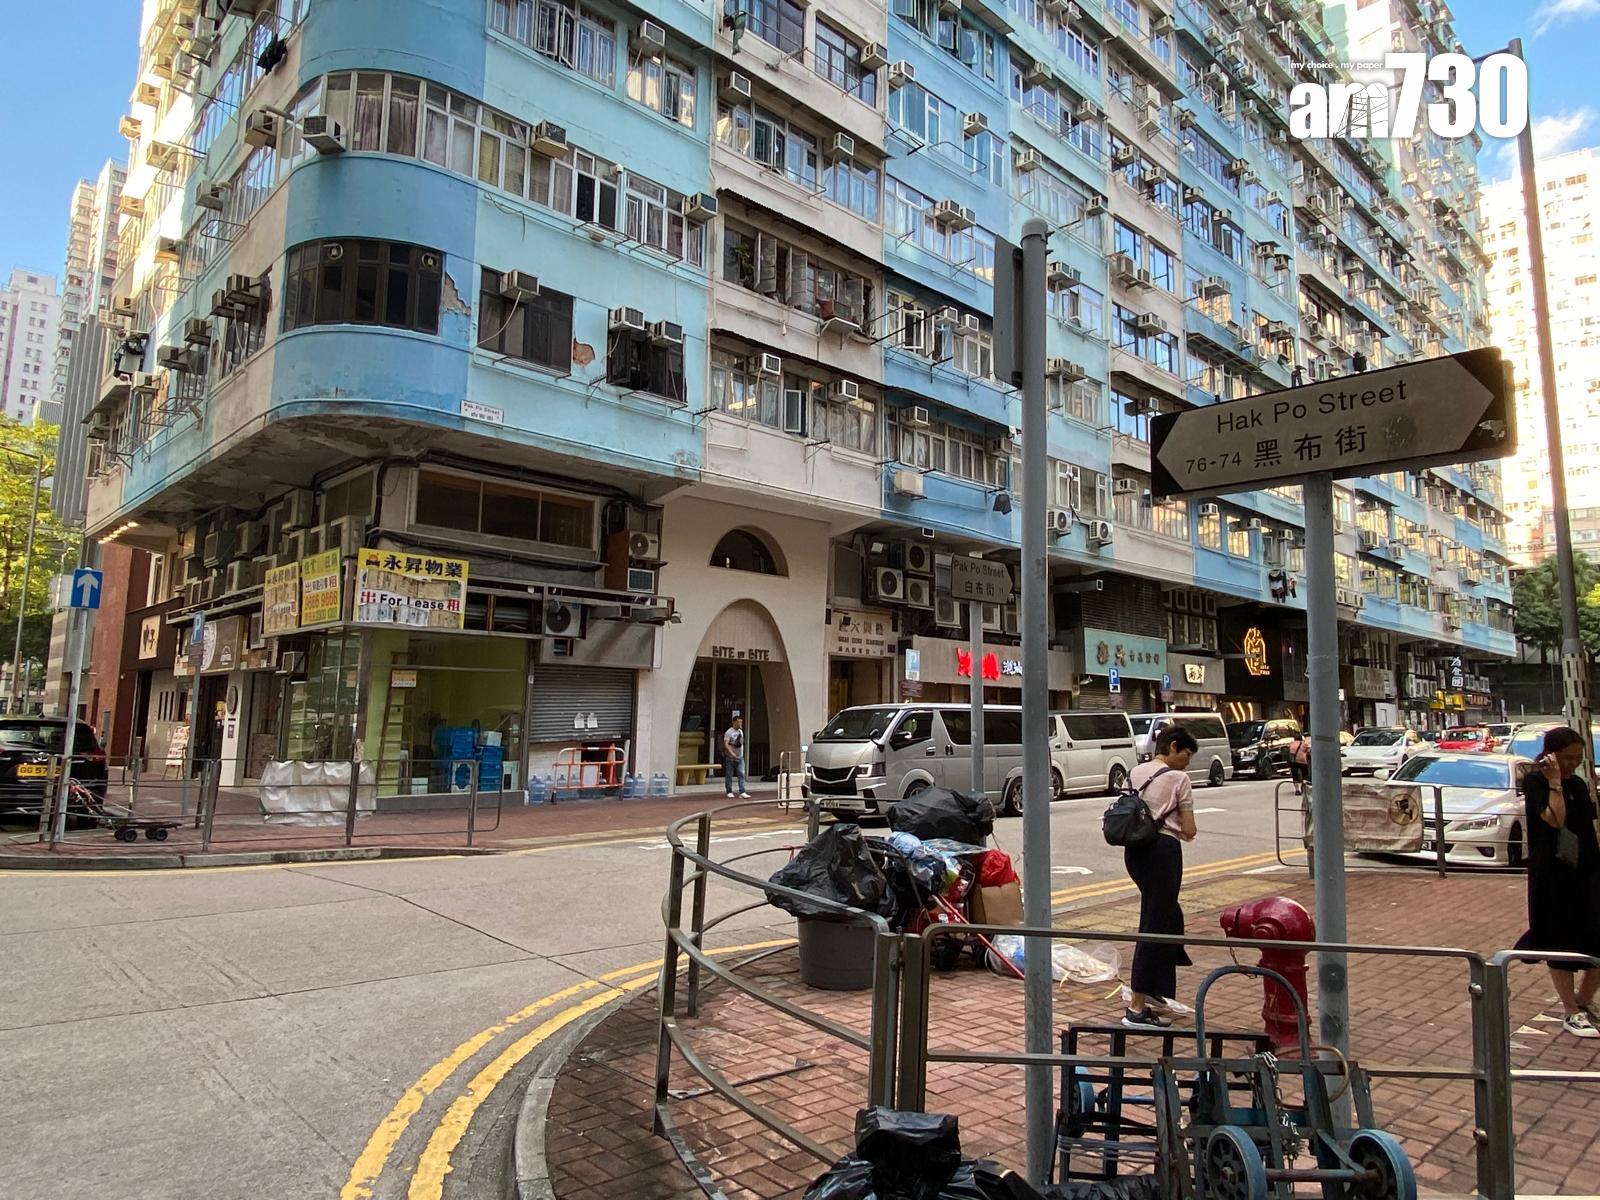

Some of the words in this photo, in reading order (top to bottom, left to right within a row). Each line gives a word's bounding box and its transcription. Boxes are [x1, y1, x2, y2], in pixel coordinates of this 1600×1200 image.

[1216, 406, 1264, 435] Hak
[1273, 400, 1307, 425] Po
[1318, 379, 1408, 415] Street
[1185, 451, 1242, 475] 76-74
[1253, 425, 1367, 469] 黑布街
[383, 554, 463, 578] 永昇物業
[954, 560, 968, 572] Pak
[970, 562, 980, 575] Po
[982, 564, 1005, 578] Street
[380, 594, 402, 606] For
[1110, 669, 1118, 684] P
[1163, 674, 1170, 688] P
